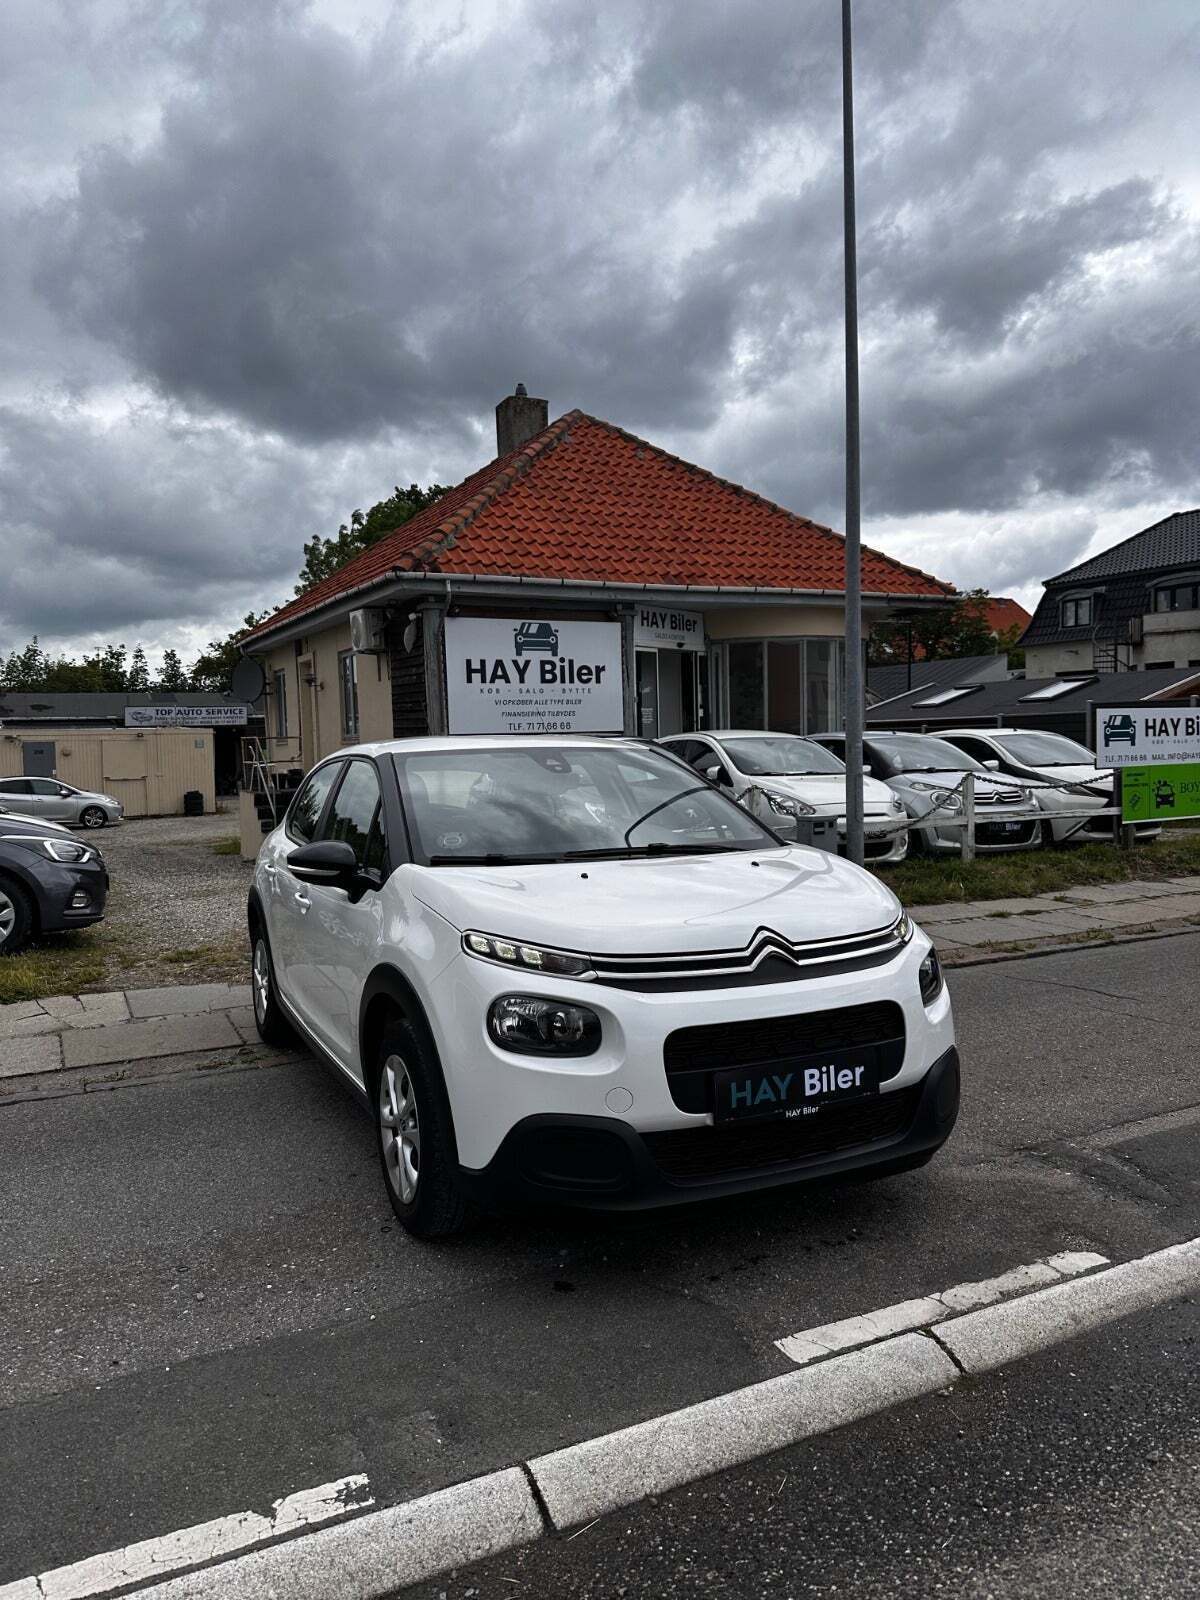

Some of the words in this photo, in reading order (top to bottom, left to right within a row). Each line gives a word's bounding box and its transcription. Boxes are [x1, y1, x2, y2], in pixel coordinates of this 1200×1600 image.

[640, 610, 667, 629] HAY
[670, 613, 698, 632] Biler
[465, 658, 532, 684] HAY
[539, 657, 606, 684] Biler
[175, 708, 202, 716] AUTO
[205, 708, 244, 716] SERVICE
[1144, 717, 1181, 737] HAY
[730, 1072, 795, 1109] HAY
[803, 1064, 865, 1096] Biler
[785, 1108, 801, 1118] HAY
[802, 1106, 819, 1116] Biler
